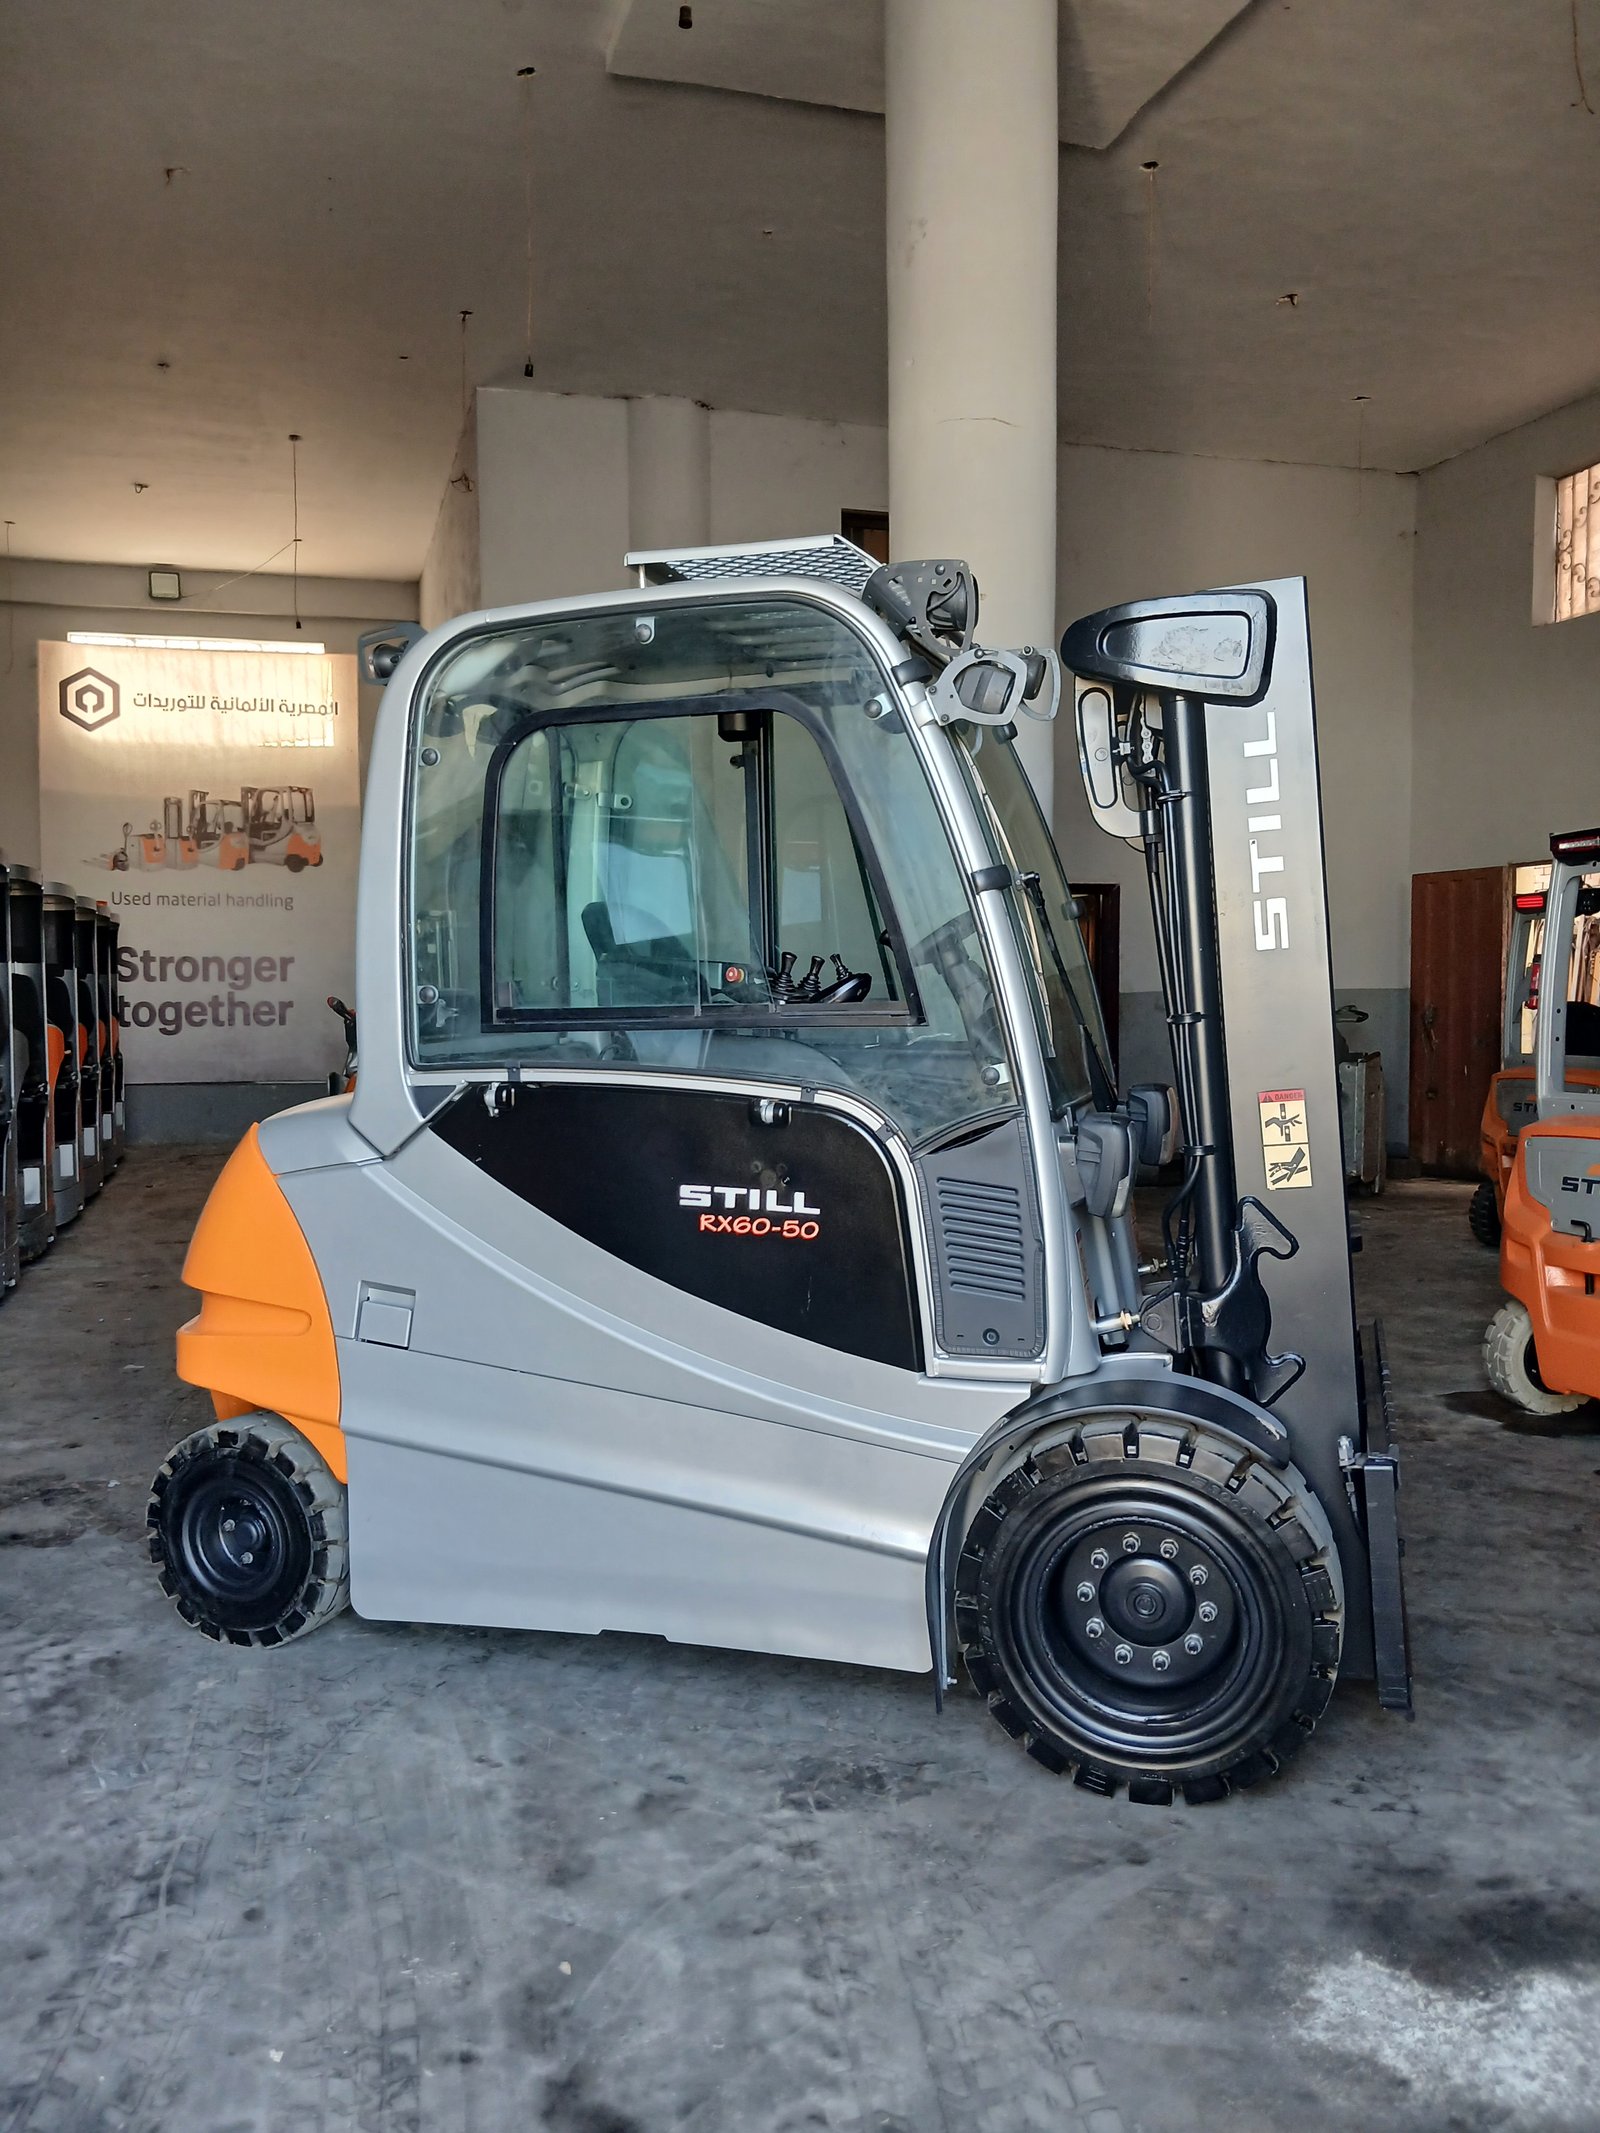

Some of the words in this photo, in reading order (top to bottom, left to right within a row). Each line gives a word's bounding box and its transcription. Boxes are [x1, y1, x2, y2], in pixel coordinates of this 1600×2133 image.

[133, 692, 206, 712] للتوريدات
[210, 696, 275, 714] الألمانية
[279, 699, 338, 716] المصرية
[1243, 711, 1290, 951] STILL
[111, 891, 151, 906] Used
[156, 893, 220, 907] material
[226, 894, 294, 911] handling
[117, 946, 295, 990] Stronger
[118, 991, 294, 1036] together
[679, 1184, 821, 1215] STILL
[699, 1213, 820, 1240] RX60-50
